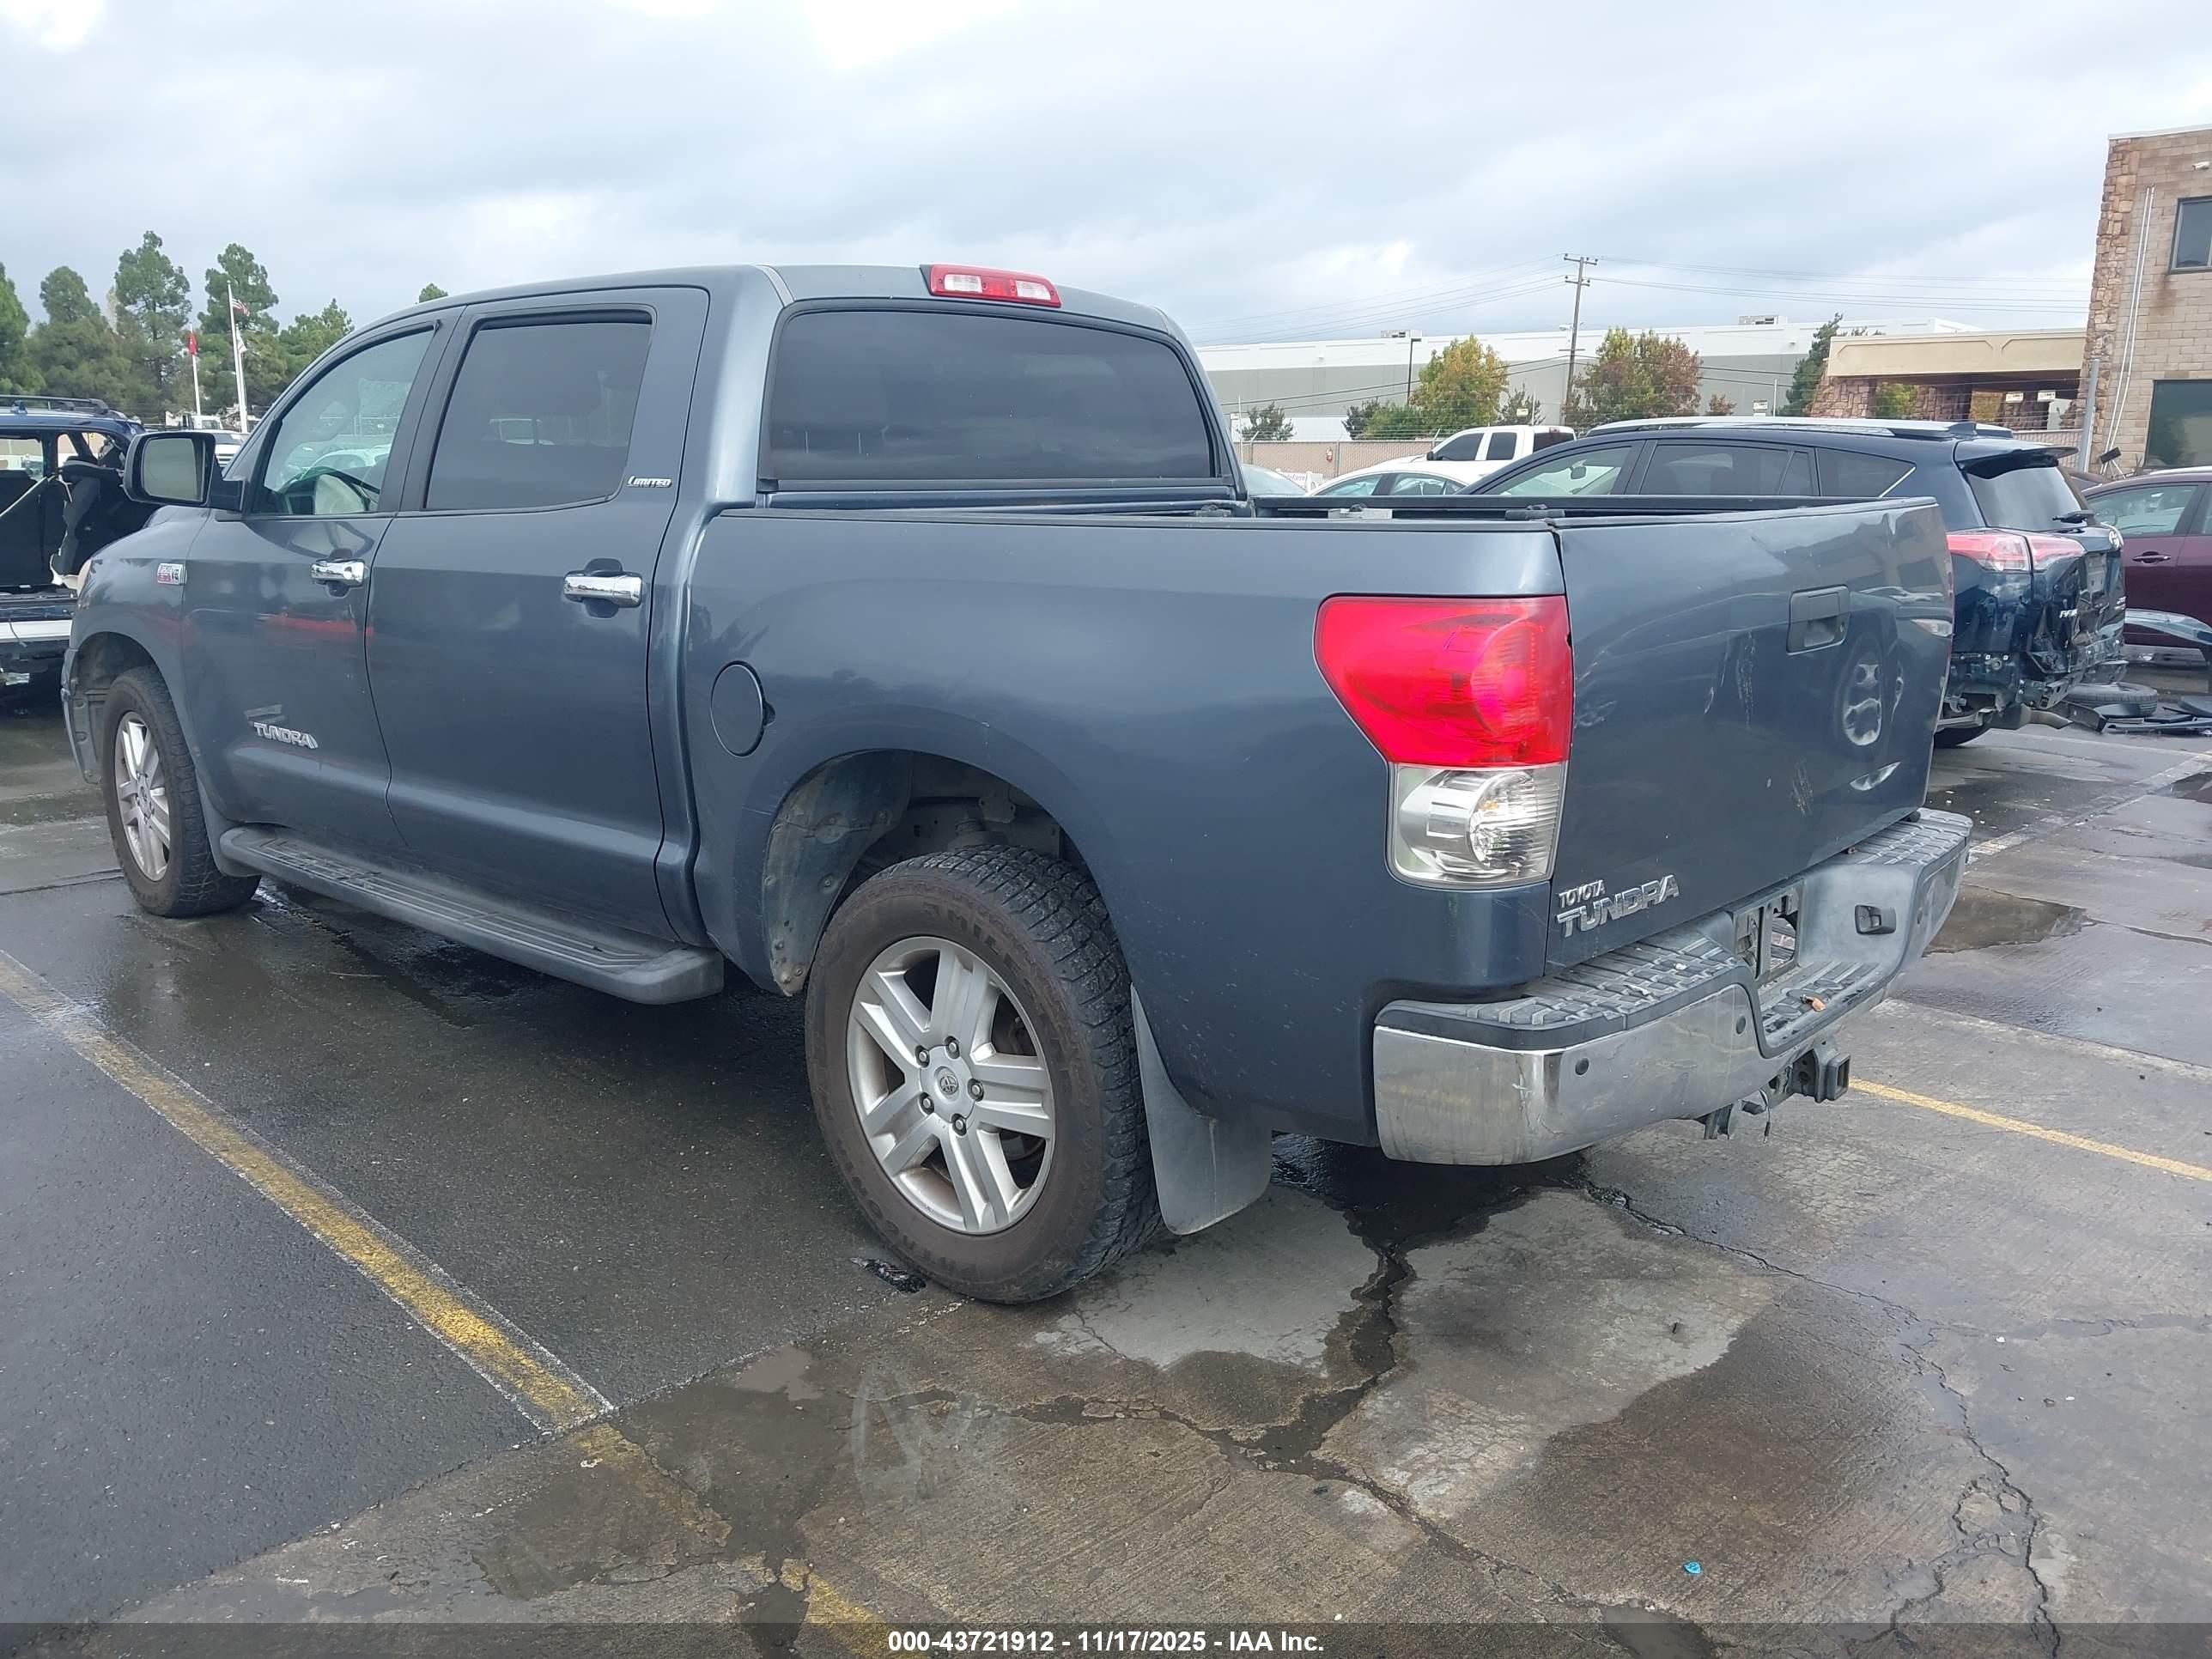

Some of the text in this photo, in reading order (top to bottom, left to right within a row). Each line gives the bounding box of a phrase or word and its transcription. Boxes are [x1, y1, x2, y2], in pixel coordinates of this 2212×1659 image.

[627, 476, 672, 488] LIMITED
[253, 721, 319, 750] TUNDRA
[1556, 874, 1680, 938] TUNDRA
[1558, 878, 1606, 908] TOYOTA
